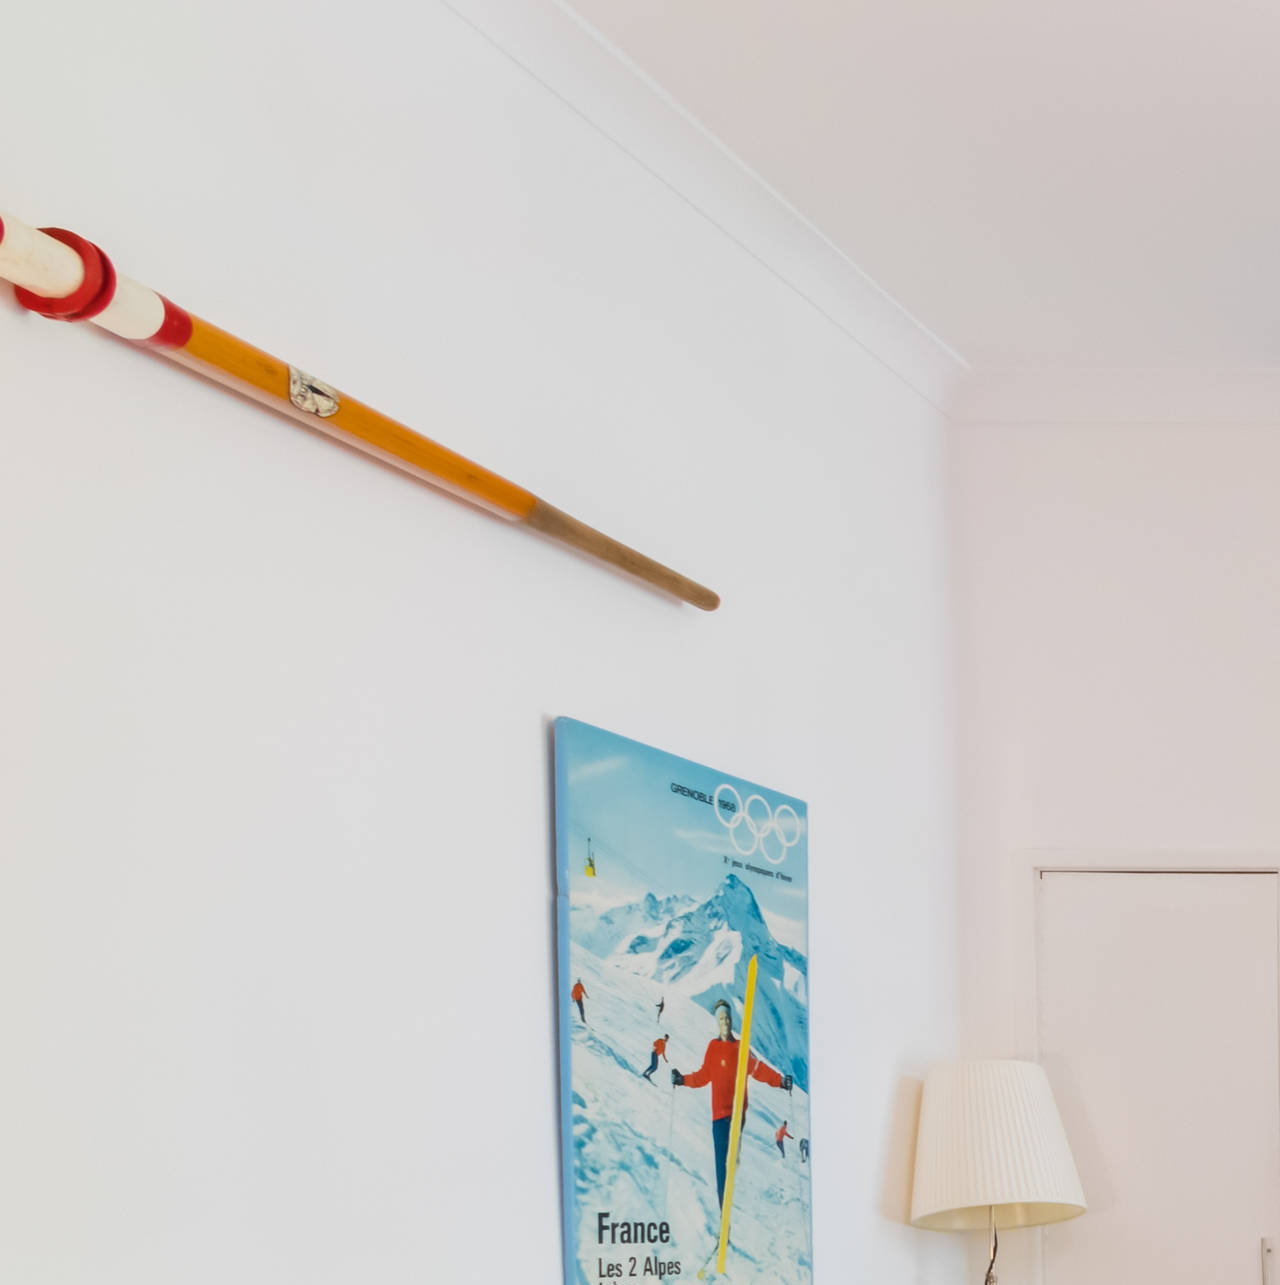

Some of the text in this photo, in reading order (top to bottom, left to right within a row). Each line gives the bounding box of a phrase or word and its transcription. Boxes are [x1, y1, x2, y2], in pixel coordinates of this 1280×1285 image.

[671, 783, 715, 806] GRENOBLE
[598, 1212, 670, 1245] France
[599, 1256, 682, 1281] Les 2 Alpes
